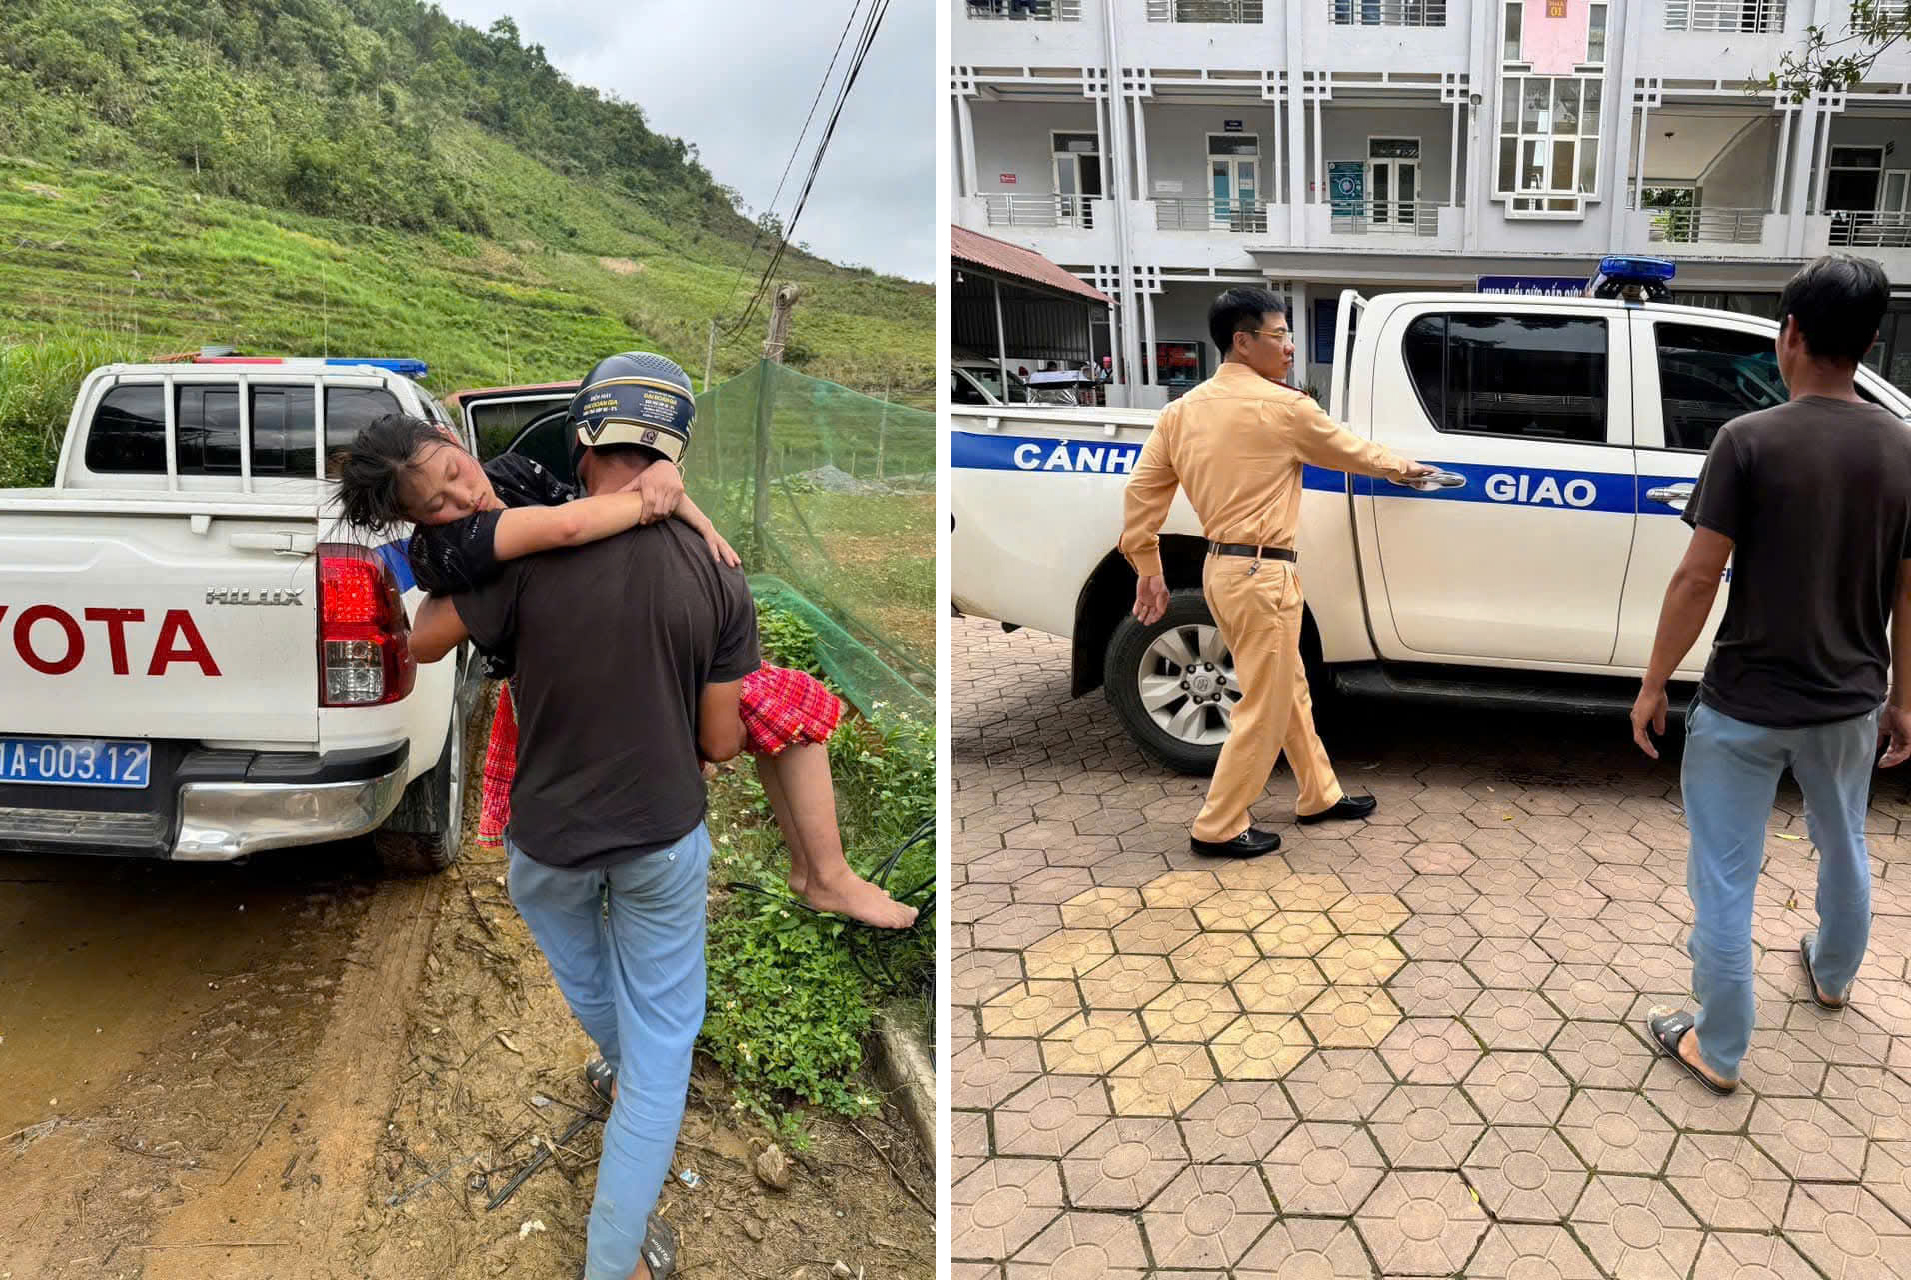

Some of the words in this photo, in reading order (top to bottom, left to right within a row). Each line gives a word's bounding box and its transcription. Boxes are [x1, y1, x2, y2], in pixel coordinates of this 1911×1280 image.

[1013, 440, 1136, 472] CẢNH
[1485, 473, 1596, 507] GIAO
[206, 587, 304, 606] HILUX
[0, 604, 222, 676] OTA
